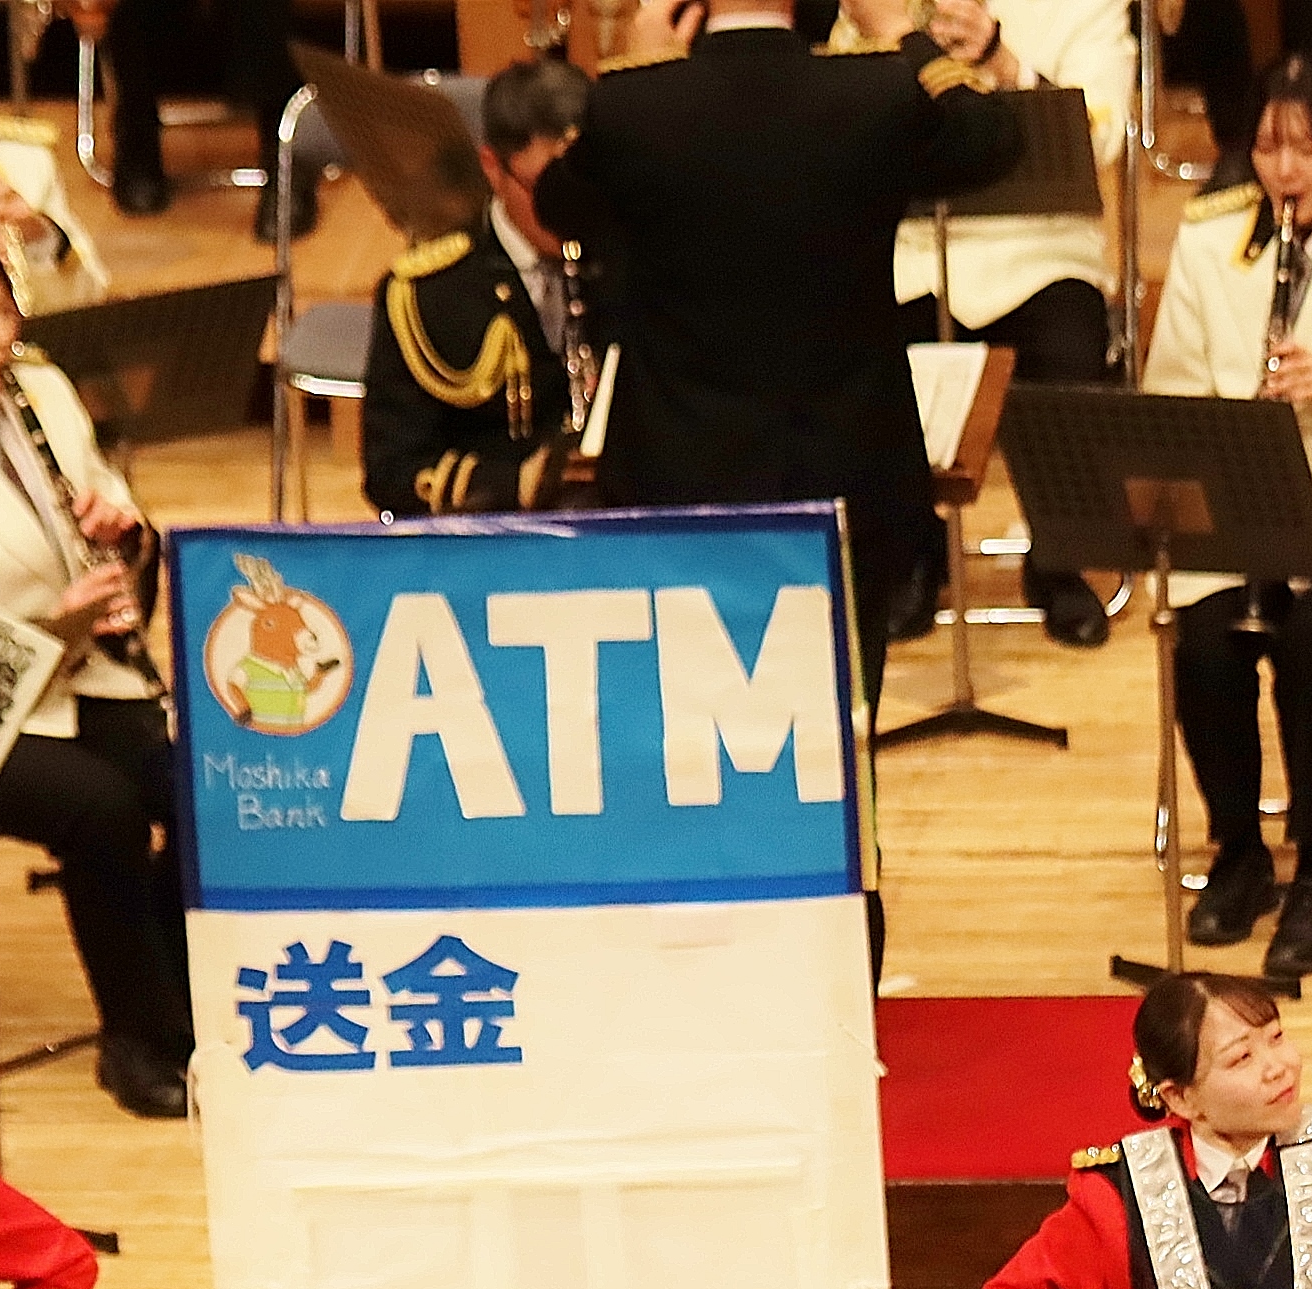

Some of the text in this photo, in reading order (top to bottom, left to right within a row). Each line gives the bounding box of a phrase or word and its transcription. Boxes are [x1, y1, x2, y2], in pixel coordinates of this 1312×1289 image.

[340, 585, 845, 822] ATM
[202, 752, 332, 792] Moshika
[237, 792, 326, 832] Bank
[236, 934, 524, 1073] 送金
